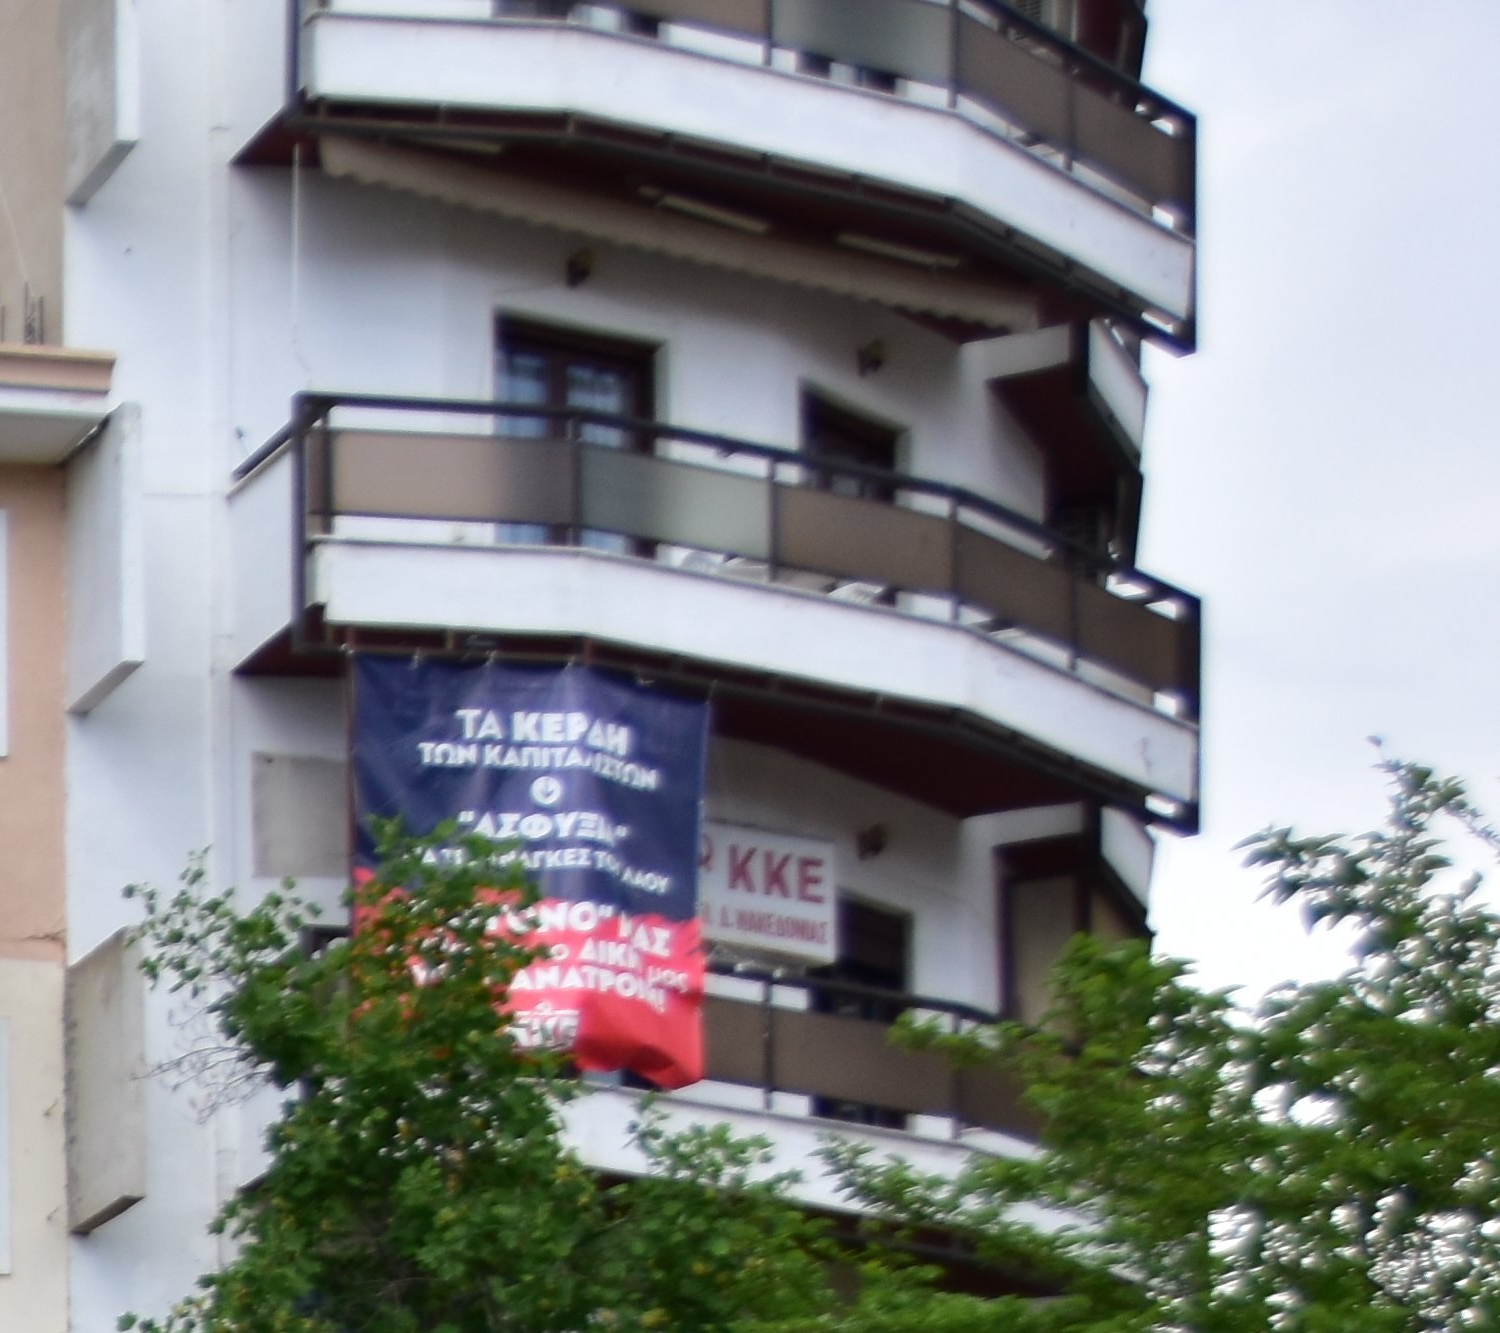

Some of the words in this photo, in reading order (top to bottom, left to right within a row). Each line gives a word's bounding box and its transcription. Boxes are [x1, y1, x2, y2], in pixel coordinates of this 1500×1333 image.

[456, 708, 503, 740] ΤΑ
[418, 741, 477, 766] ΤΩΝ
[726, 843, 826, 904] ΚΚΕ
